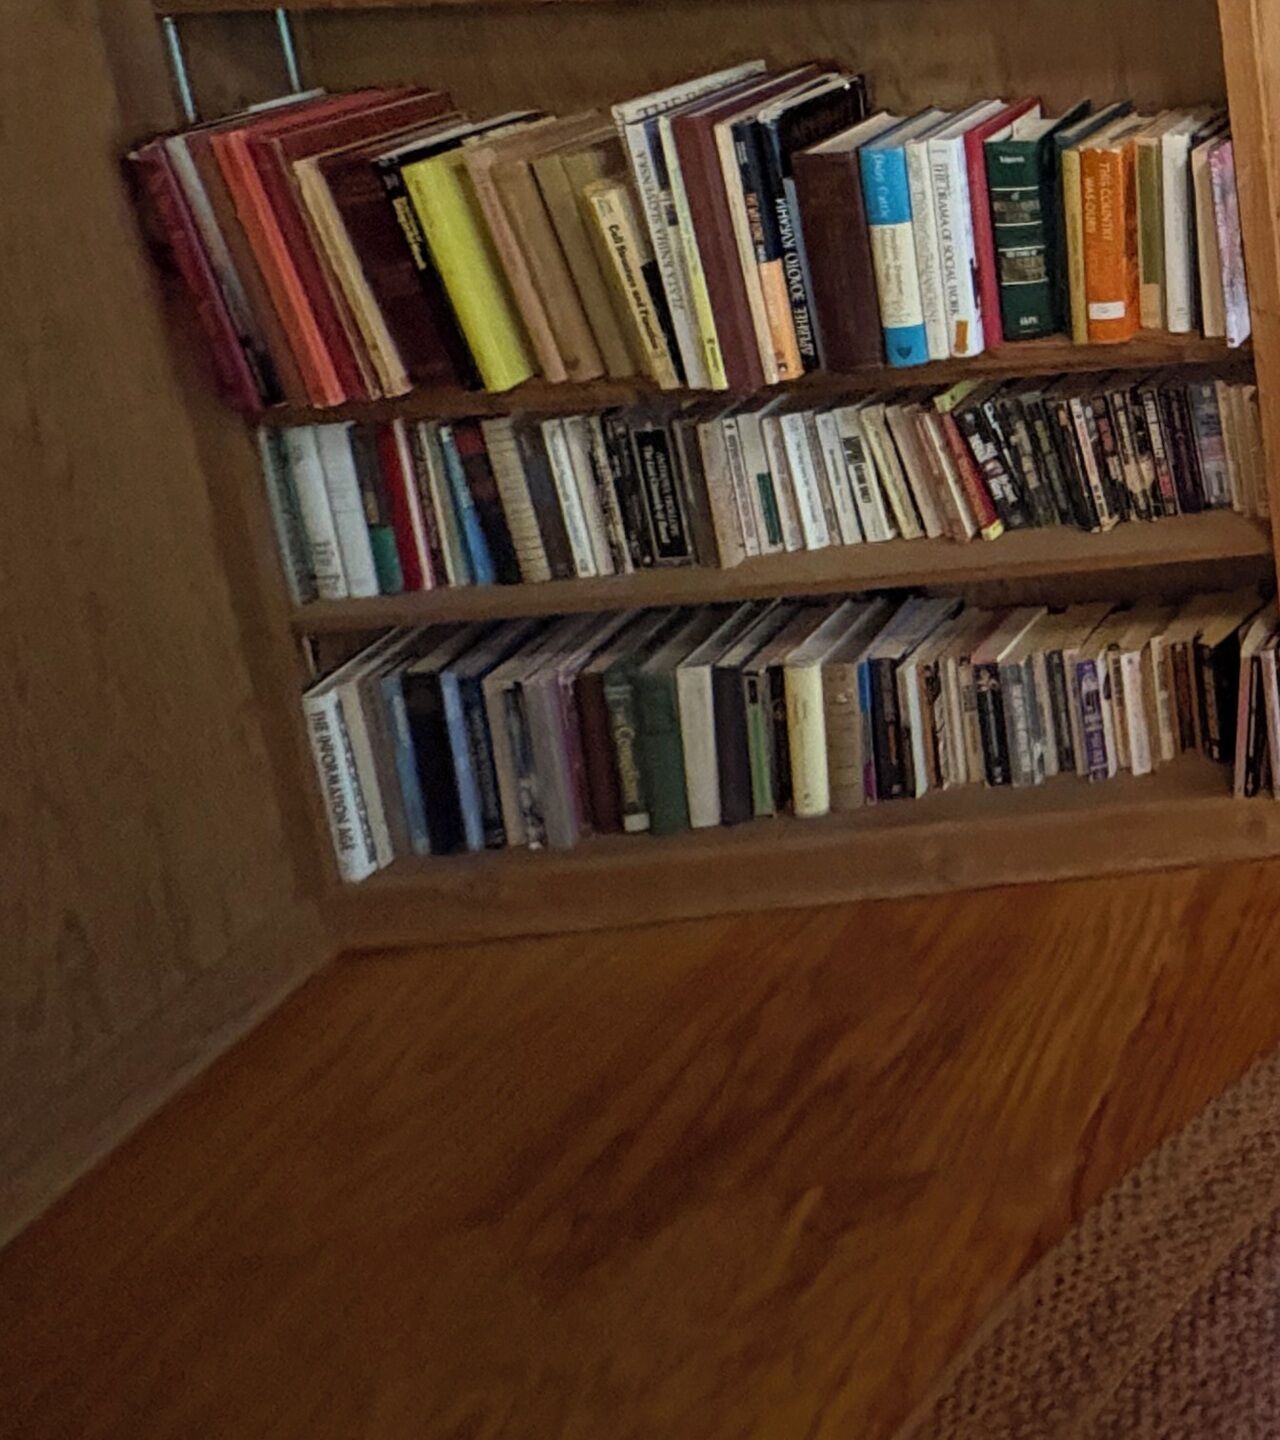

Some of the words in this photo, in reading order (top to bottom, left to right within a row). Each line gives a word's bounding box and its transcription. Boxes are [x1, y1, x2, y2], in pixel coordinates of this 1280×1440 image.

[933, 162, 948, 182] THE
[936, 186, 953, 226] DRAMA
[942, 228, 955, 242] OF
[608, 224, 626, 242] Cell
[630, 289, 645, 308] and
[942, 244, 958, 284] SOCIAL
[310, 710, 329, 733] THE
[316, 736, 346, 824] INFORMATION
[337, 828, 354, 851] AGE
